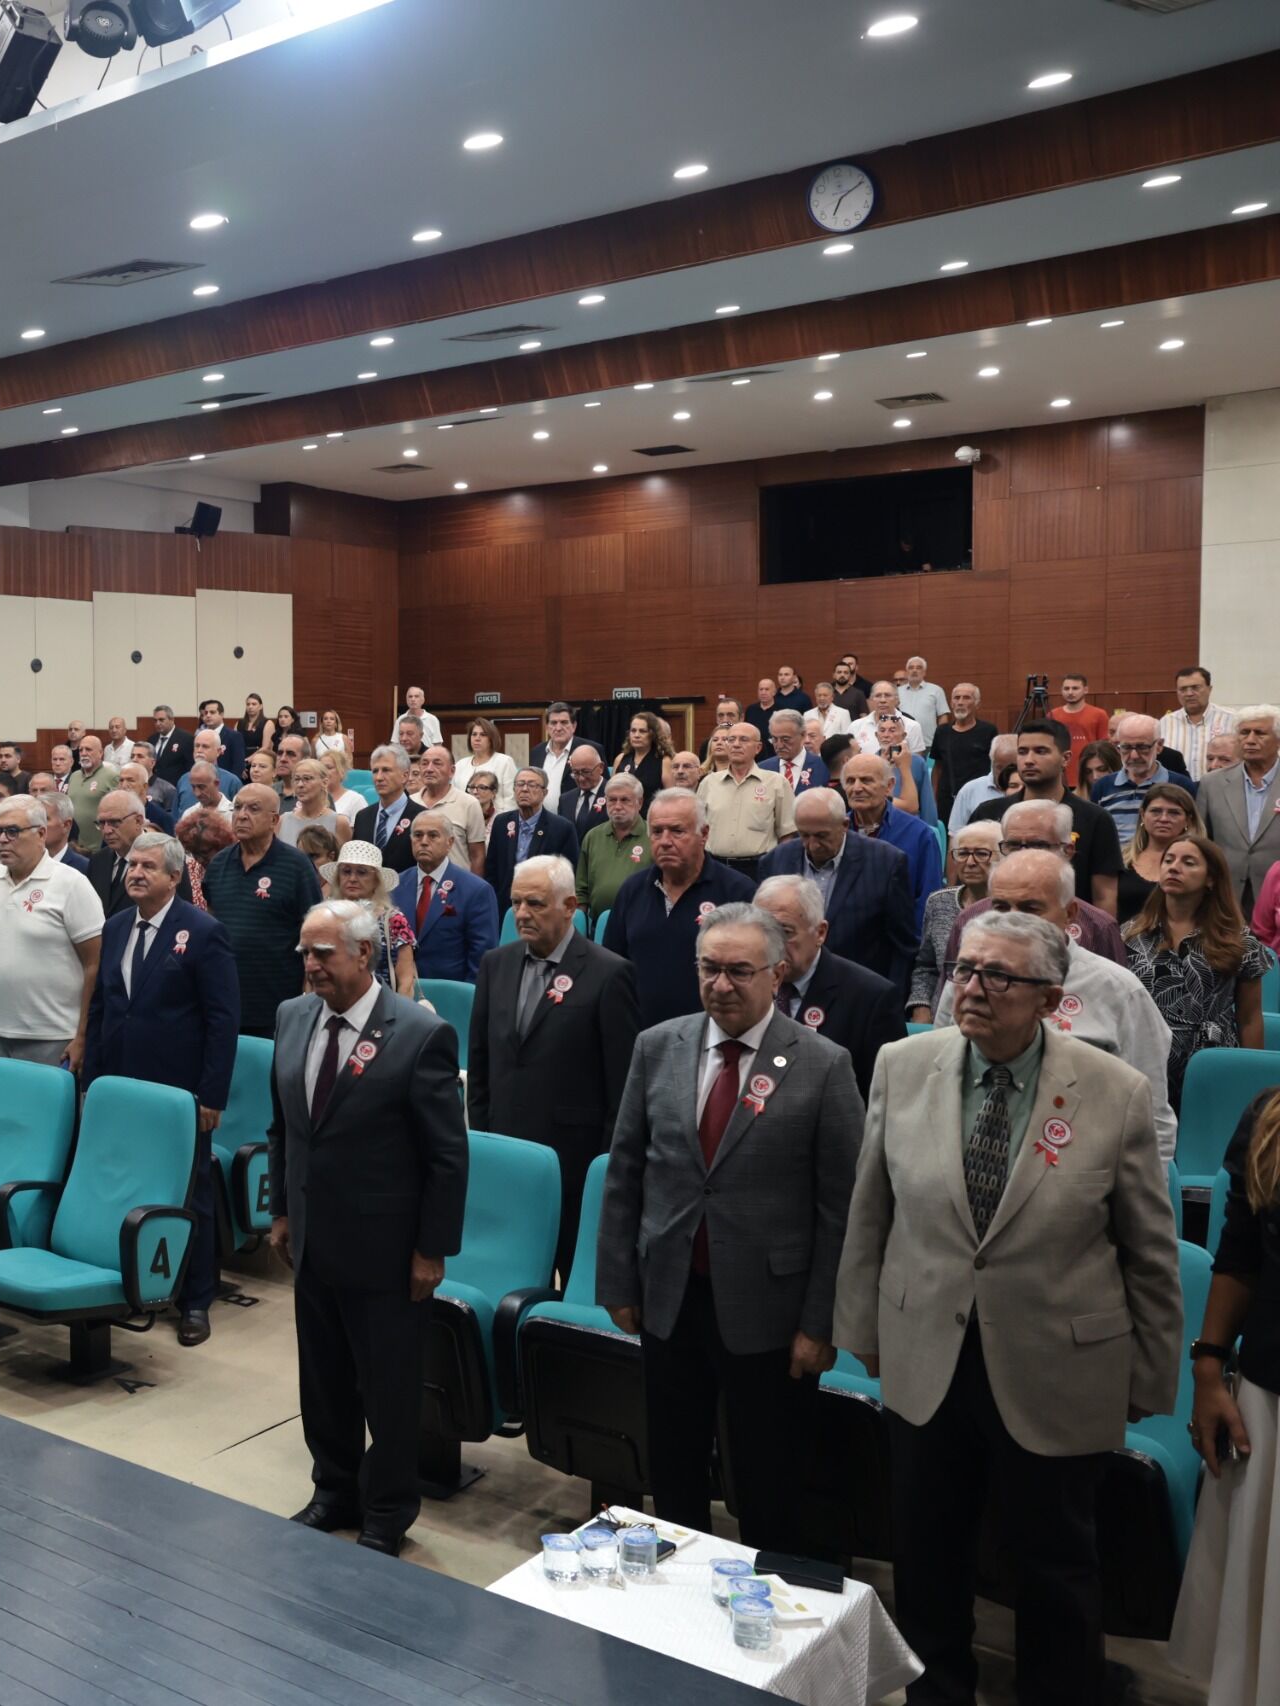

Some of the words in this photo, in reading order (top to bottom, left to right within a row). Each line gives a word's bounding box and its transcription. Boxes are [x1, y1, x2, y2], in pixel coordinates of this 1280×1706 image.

[833, 168, 842, 178] 12
[854, 210, 862, 221] 5
[150, 1237, 171, 1279] A
